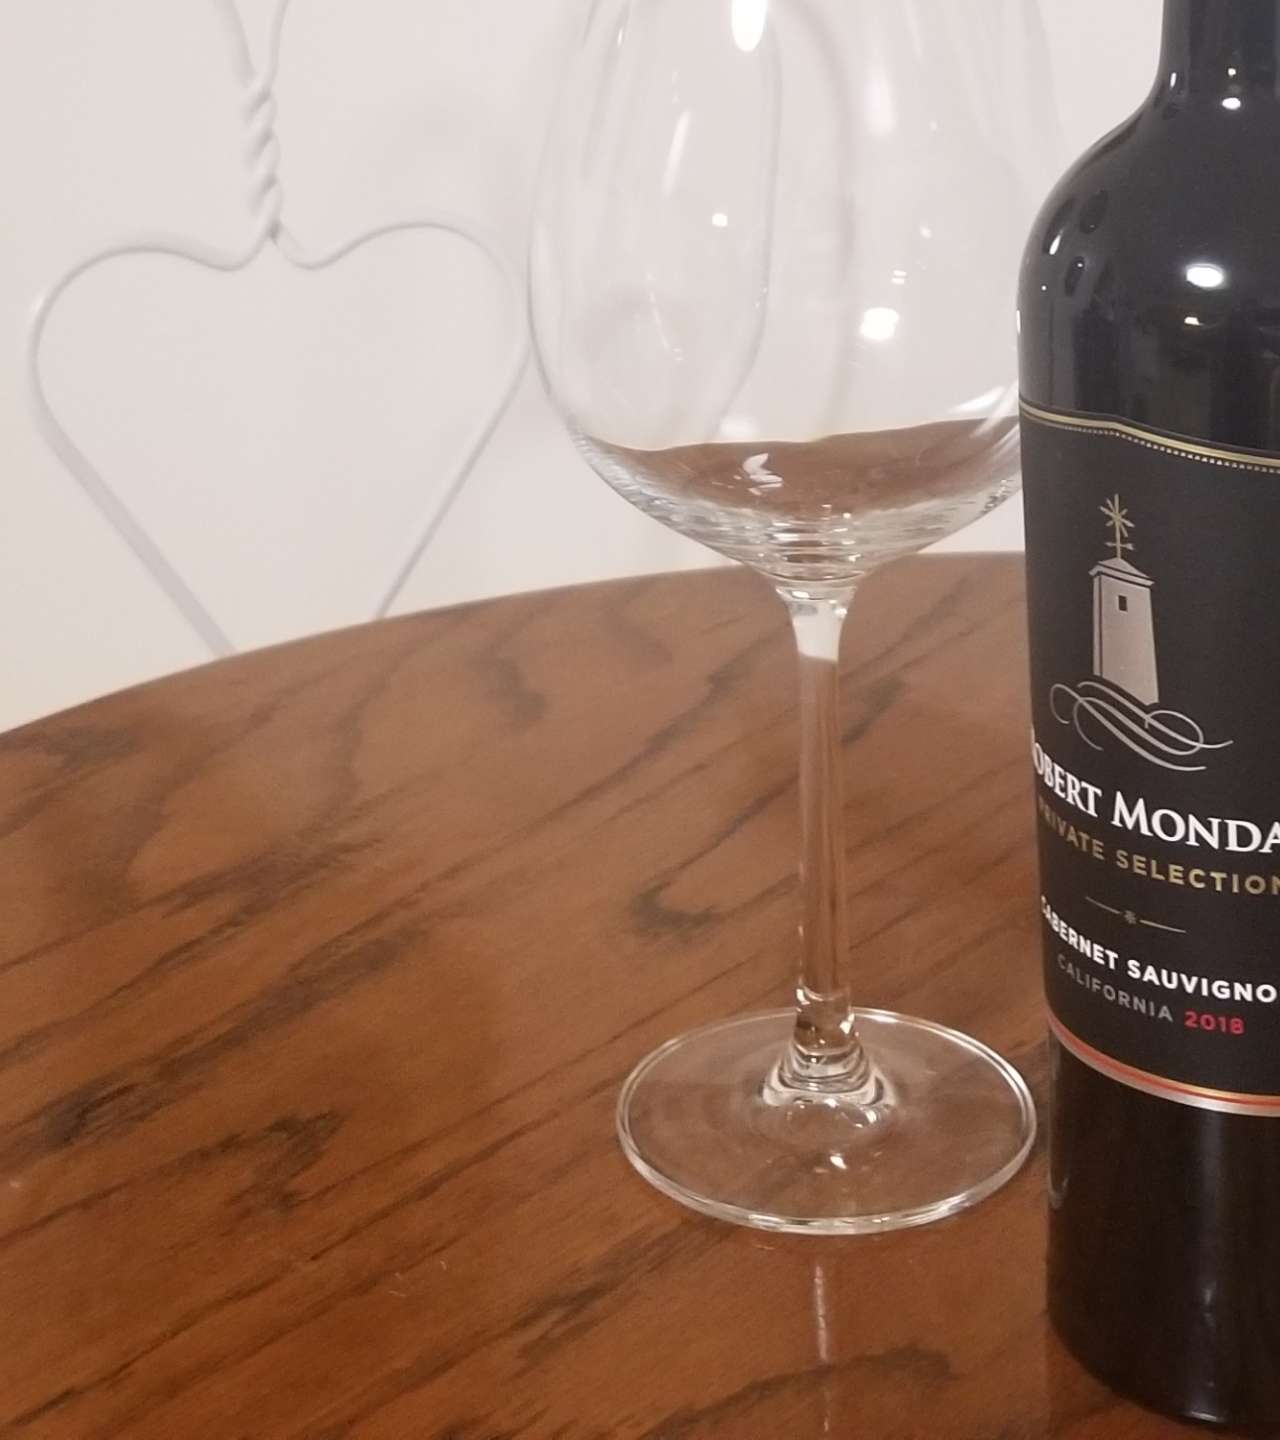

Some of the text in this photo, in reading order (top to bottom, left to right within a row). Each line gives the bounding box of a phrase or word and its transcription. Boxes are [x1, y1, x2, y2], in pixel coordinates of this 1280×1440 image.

[1031, 728, 1102, 818] OBERT
[1057, 954, 1245, 1035] CALIFORNIA 2018
